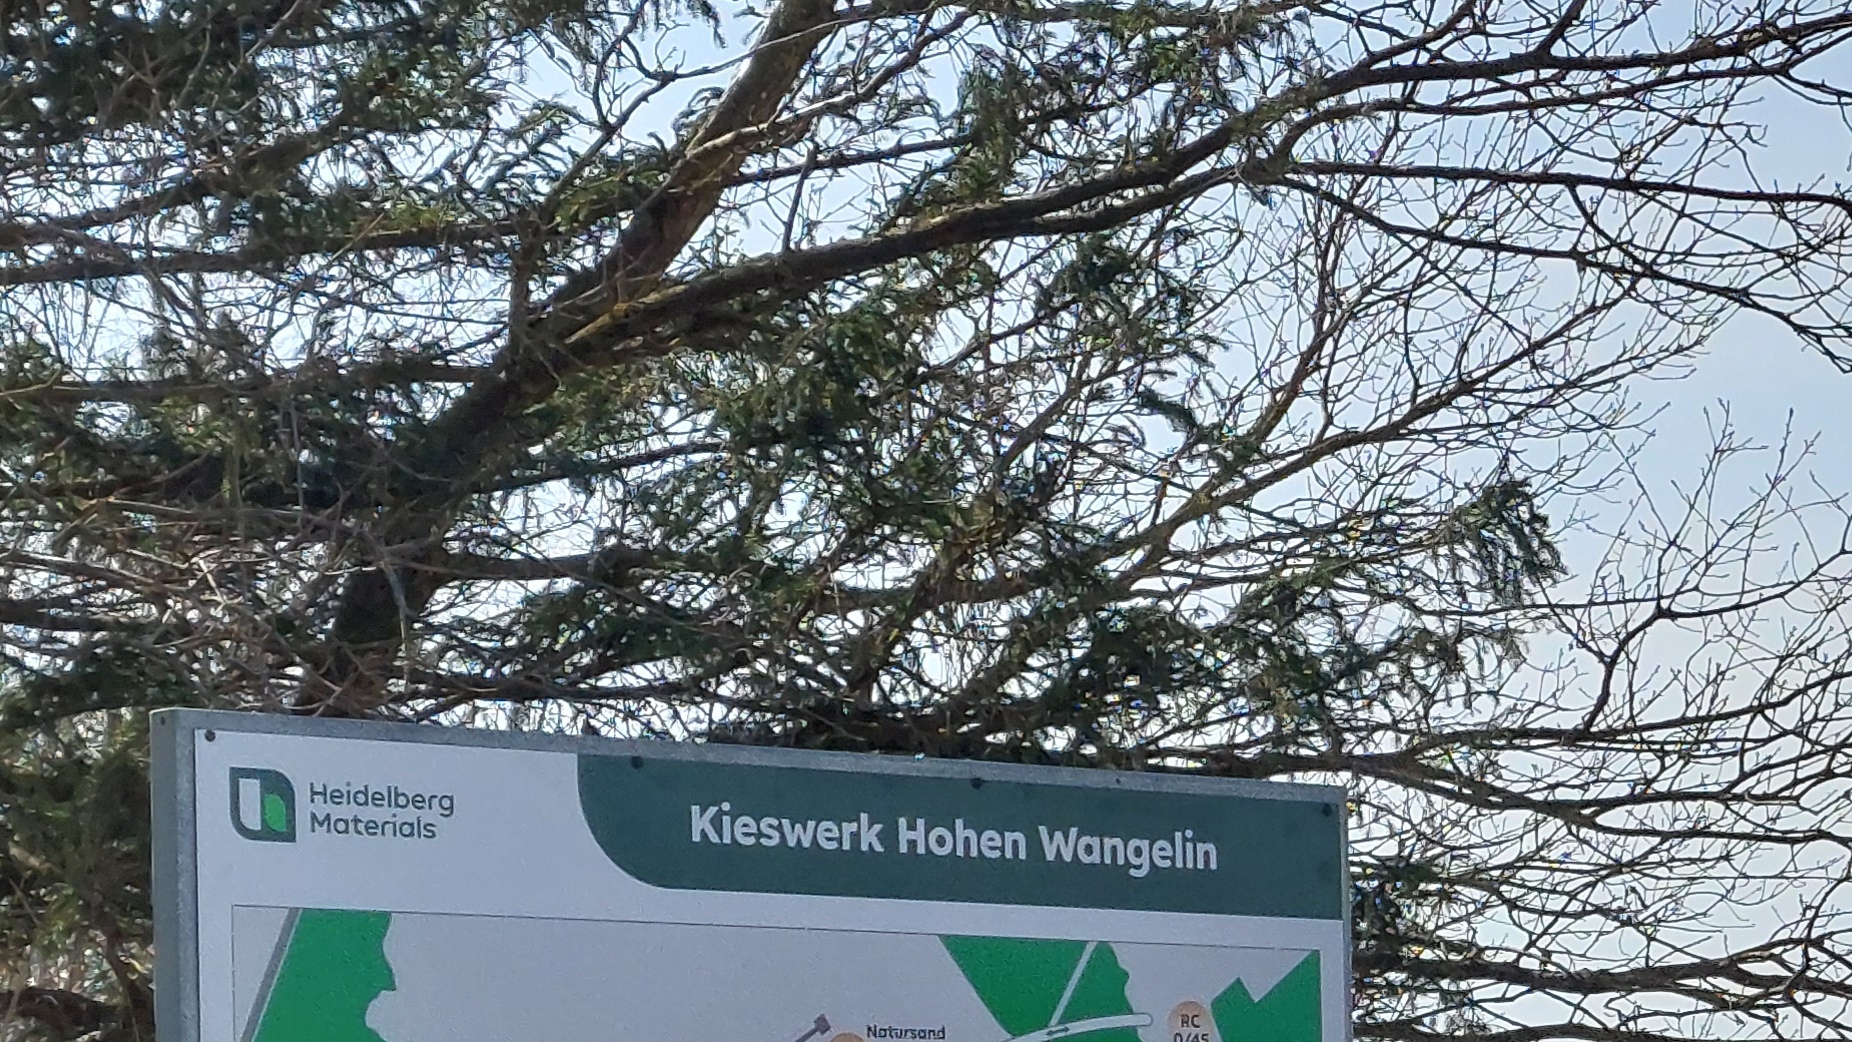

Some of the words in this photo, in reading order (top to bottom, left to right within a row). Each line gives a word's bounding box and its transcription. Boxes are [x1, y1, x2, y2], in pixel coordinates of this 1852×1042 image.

[310, 782, 455, 817] Heidelberg
[310, 811, 436, 839] Materials
[691, 802, 884, 853] Kieswerk
[898, 818, 1026, 860] Hohen
[1038, 826, 1218, 878] Wangelin
[866, 1024, 945, 1041] Natursand
[1180, 1014, 1201, 1029] RC
